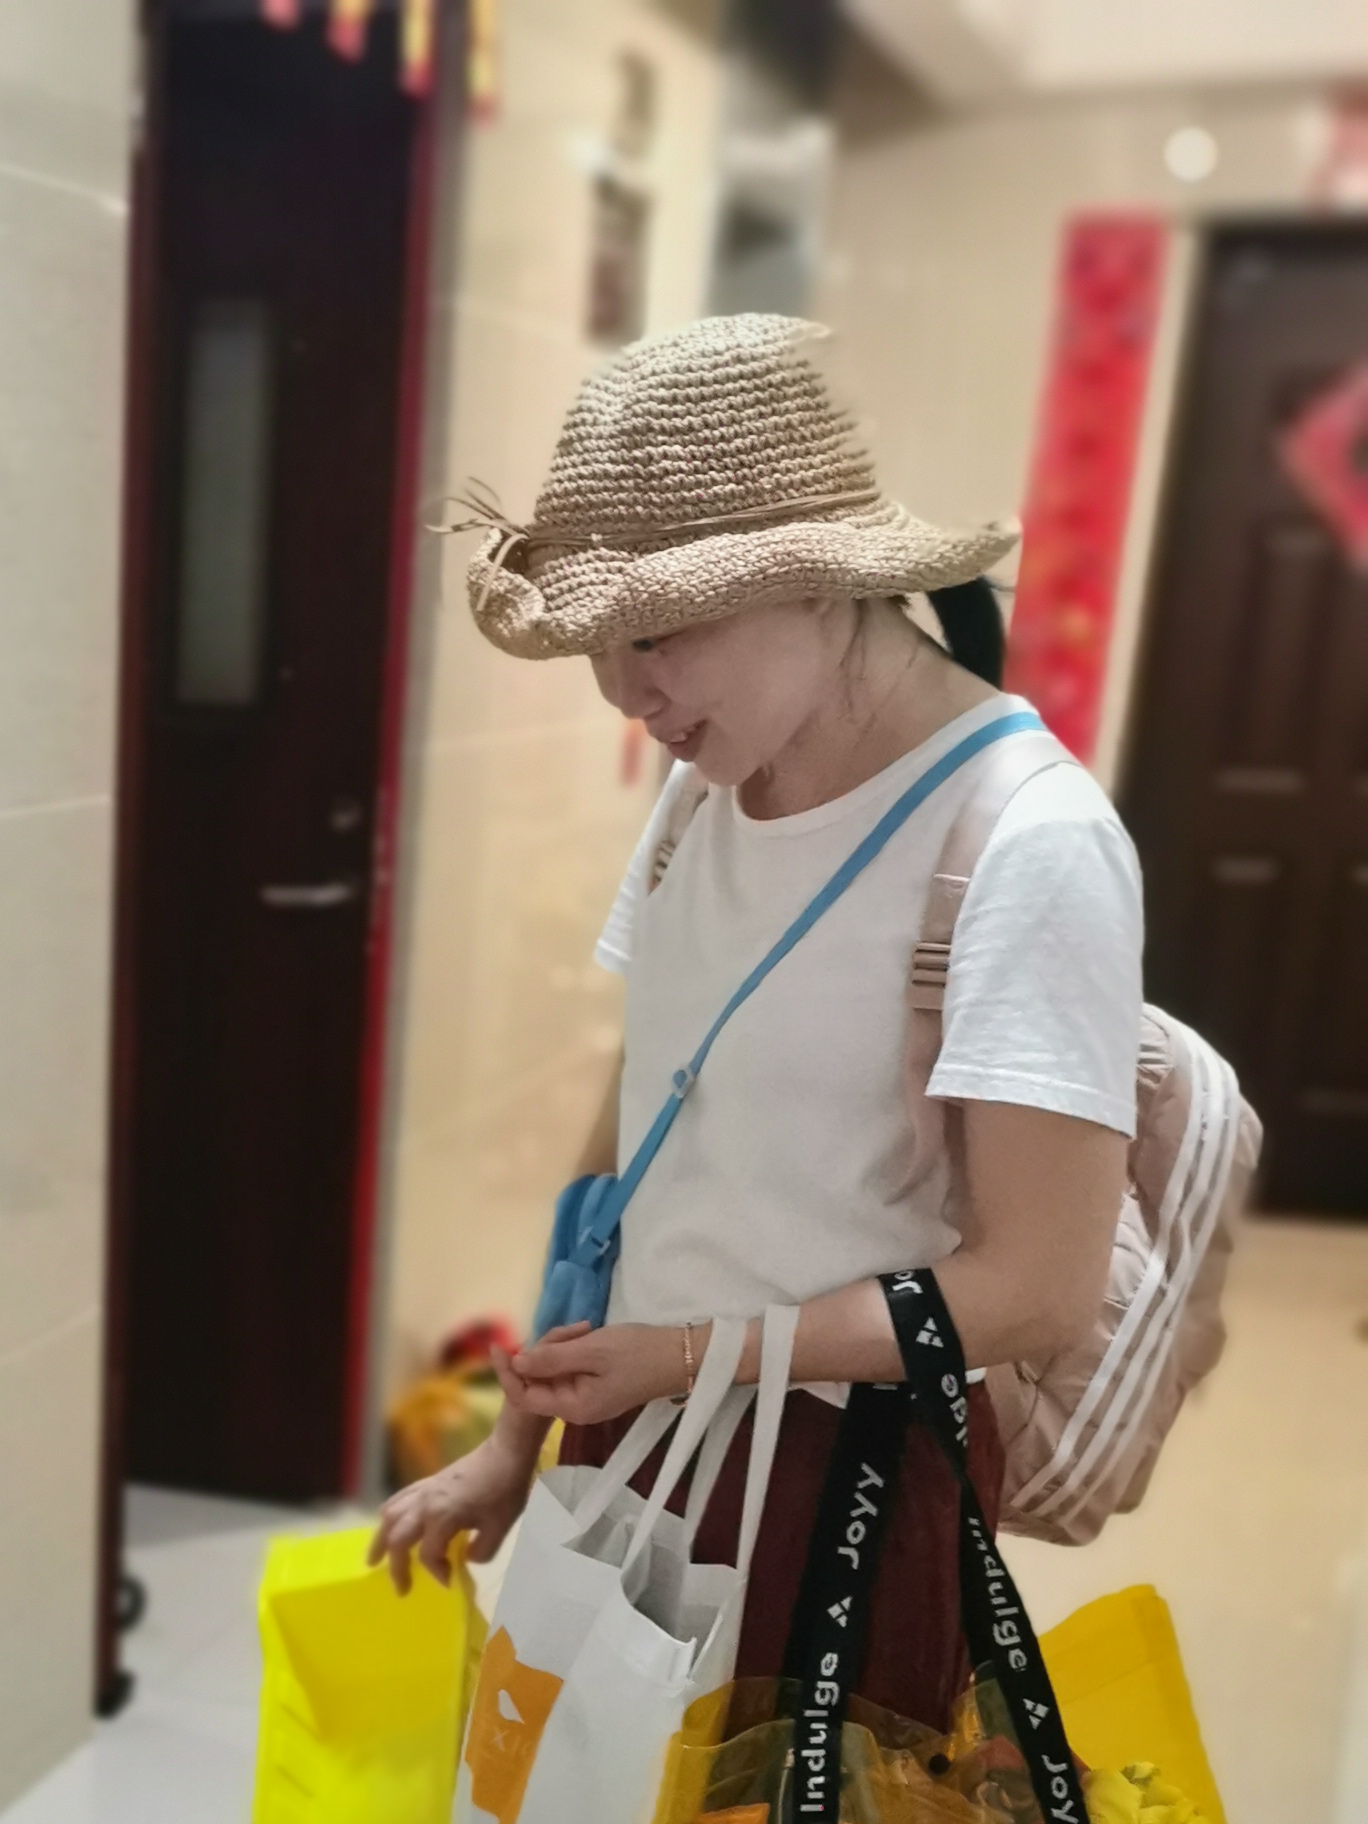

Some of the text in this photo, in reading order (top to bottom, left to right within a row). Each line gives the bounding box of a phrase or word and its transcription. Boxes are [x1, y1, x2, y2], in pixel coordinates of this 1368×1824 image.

[798, 1460, 886, 1813] Indulge Joyy
[967, 1516, 1029, 1673] Indulge
